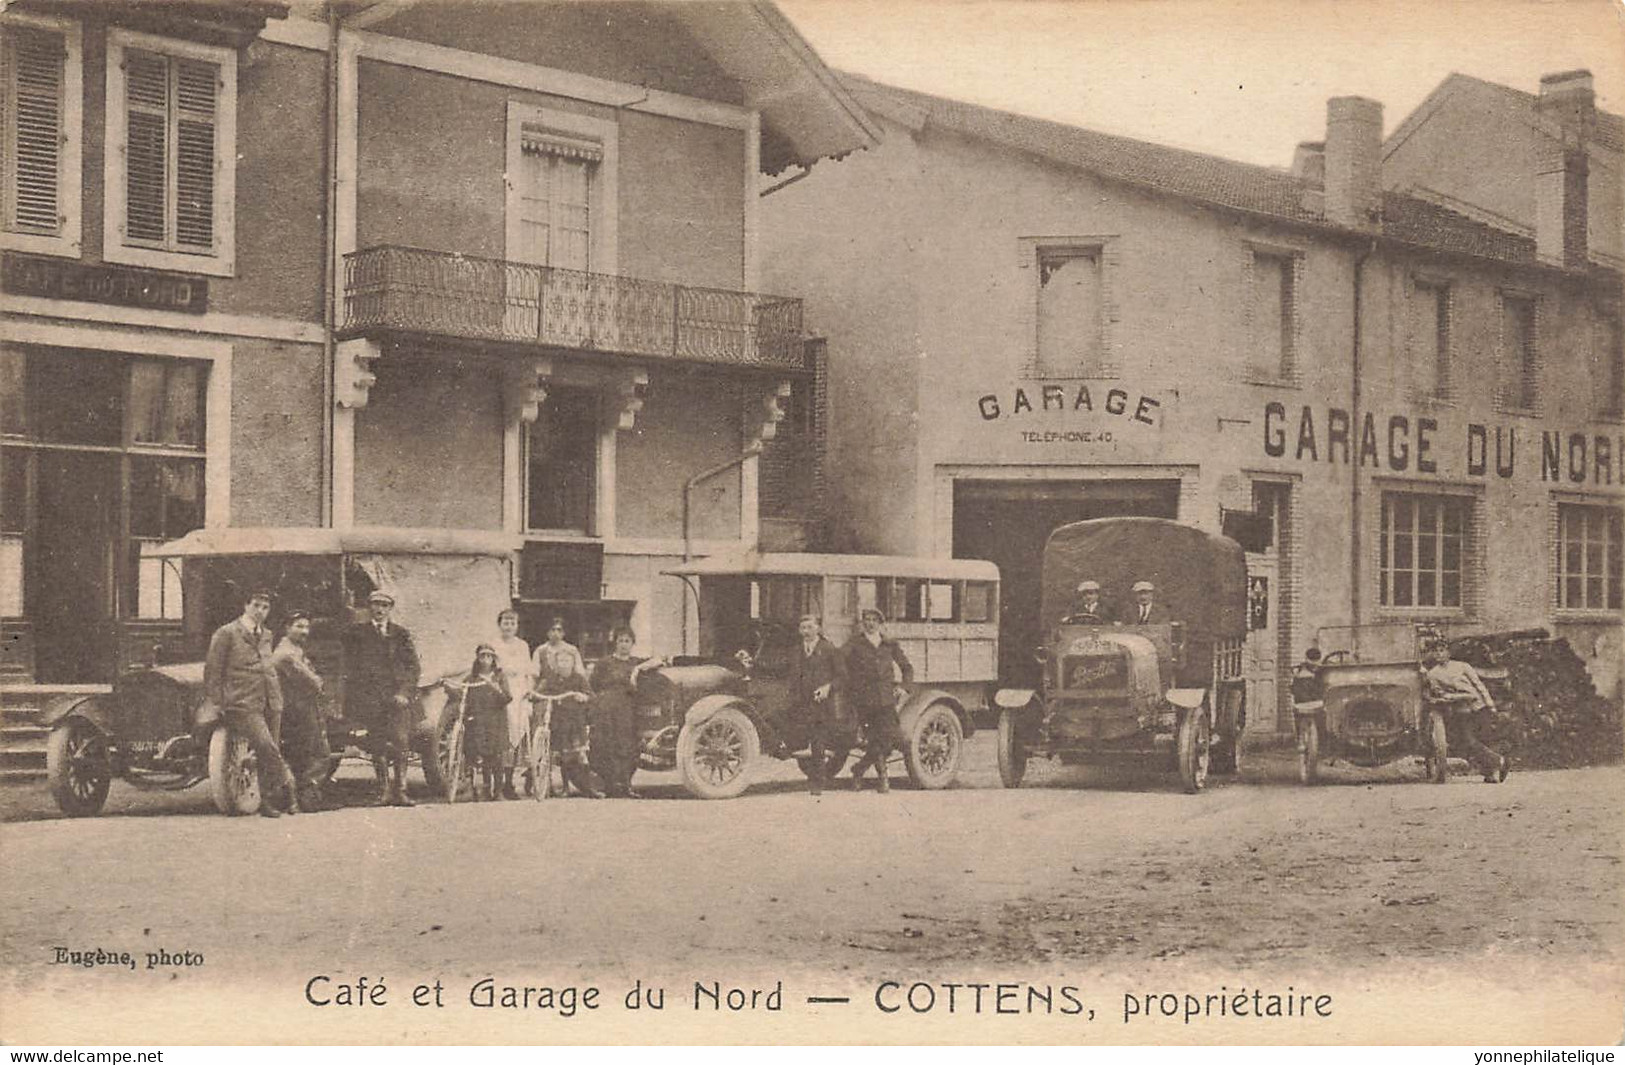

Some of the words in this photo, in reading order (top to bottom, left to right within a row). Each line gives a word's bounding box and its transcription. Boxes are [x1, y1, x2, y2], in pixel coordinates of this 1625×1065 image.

[978, 385, 1161, 425] GARAGE
[1264, 402, 1438, 472] GARAGE
[1468, 423, 1515, 478] DU
[1542, 431, 1624, 485] NOR
